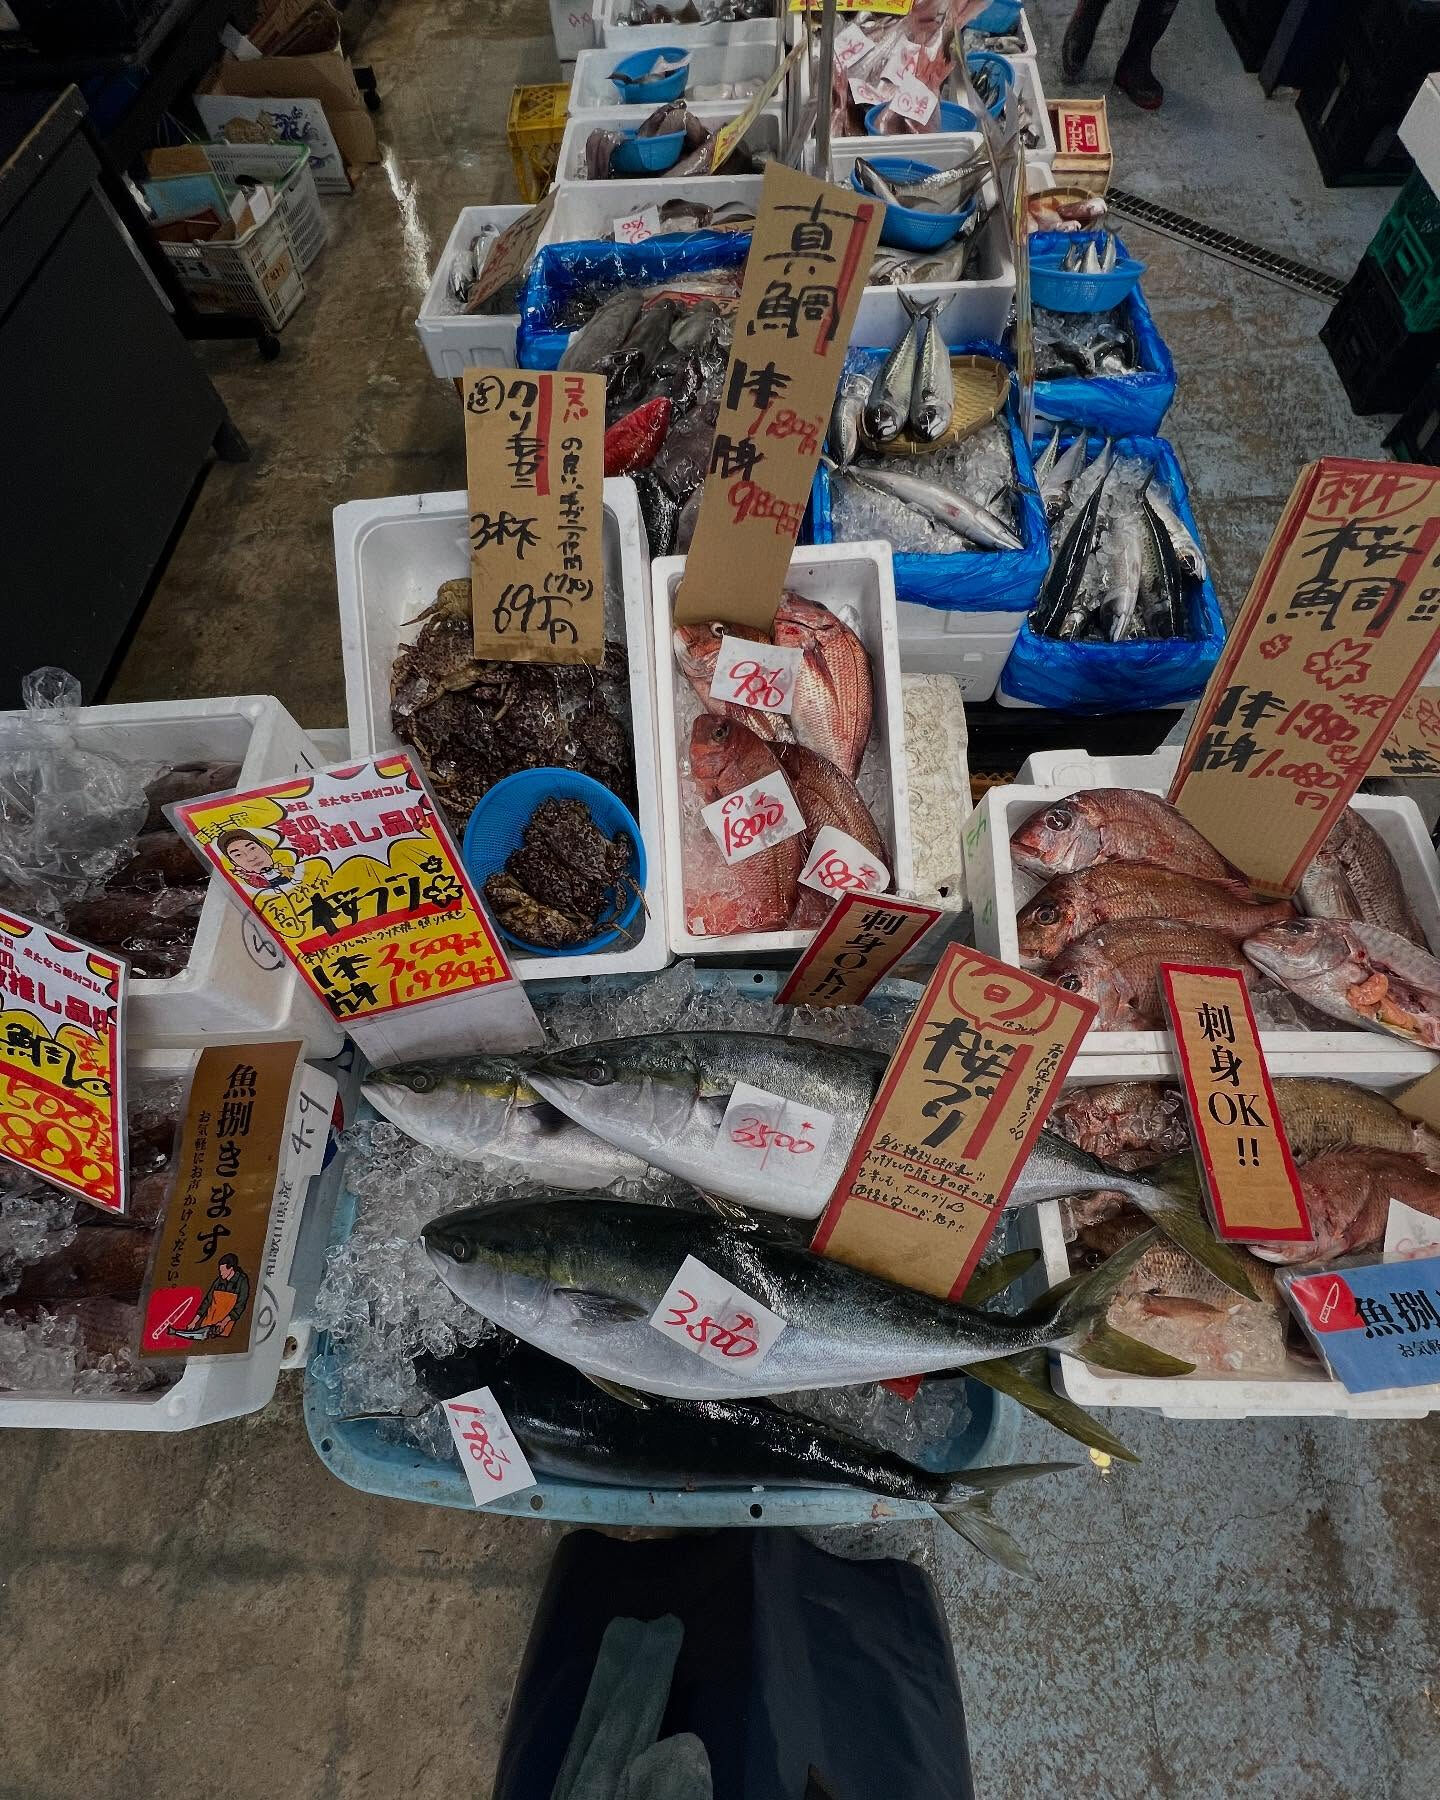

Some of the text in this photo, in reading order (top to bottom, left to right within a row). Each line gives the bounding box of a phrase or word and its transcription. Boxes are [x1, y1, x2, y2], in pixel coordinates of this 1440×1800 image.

[746, 193, 868, 342] 真鯛
[1194, 1002, 1269, 1168] 刺身OK!!
[196, 1063, 259, 1265] 魚捌きます
[1354, 1288, 1440, 1339] 魚捌
